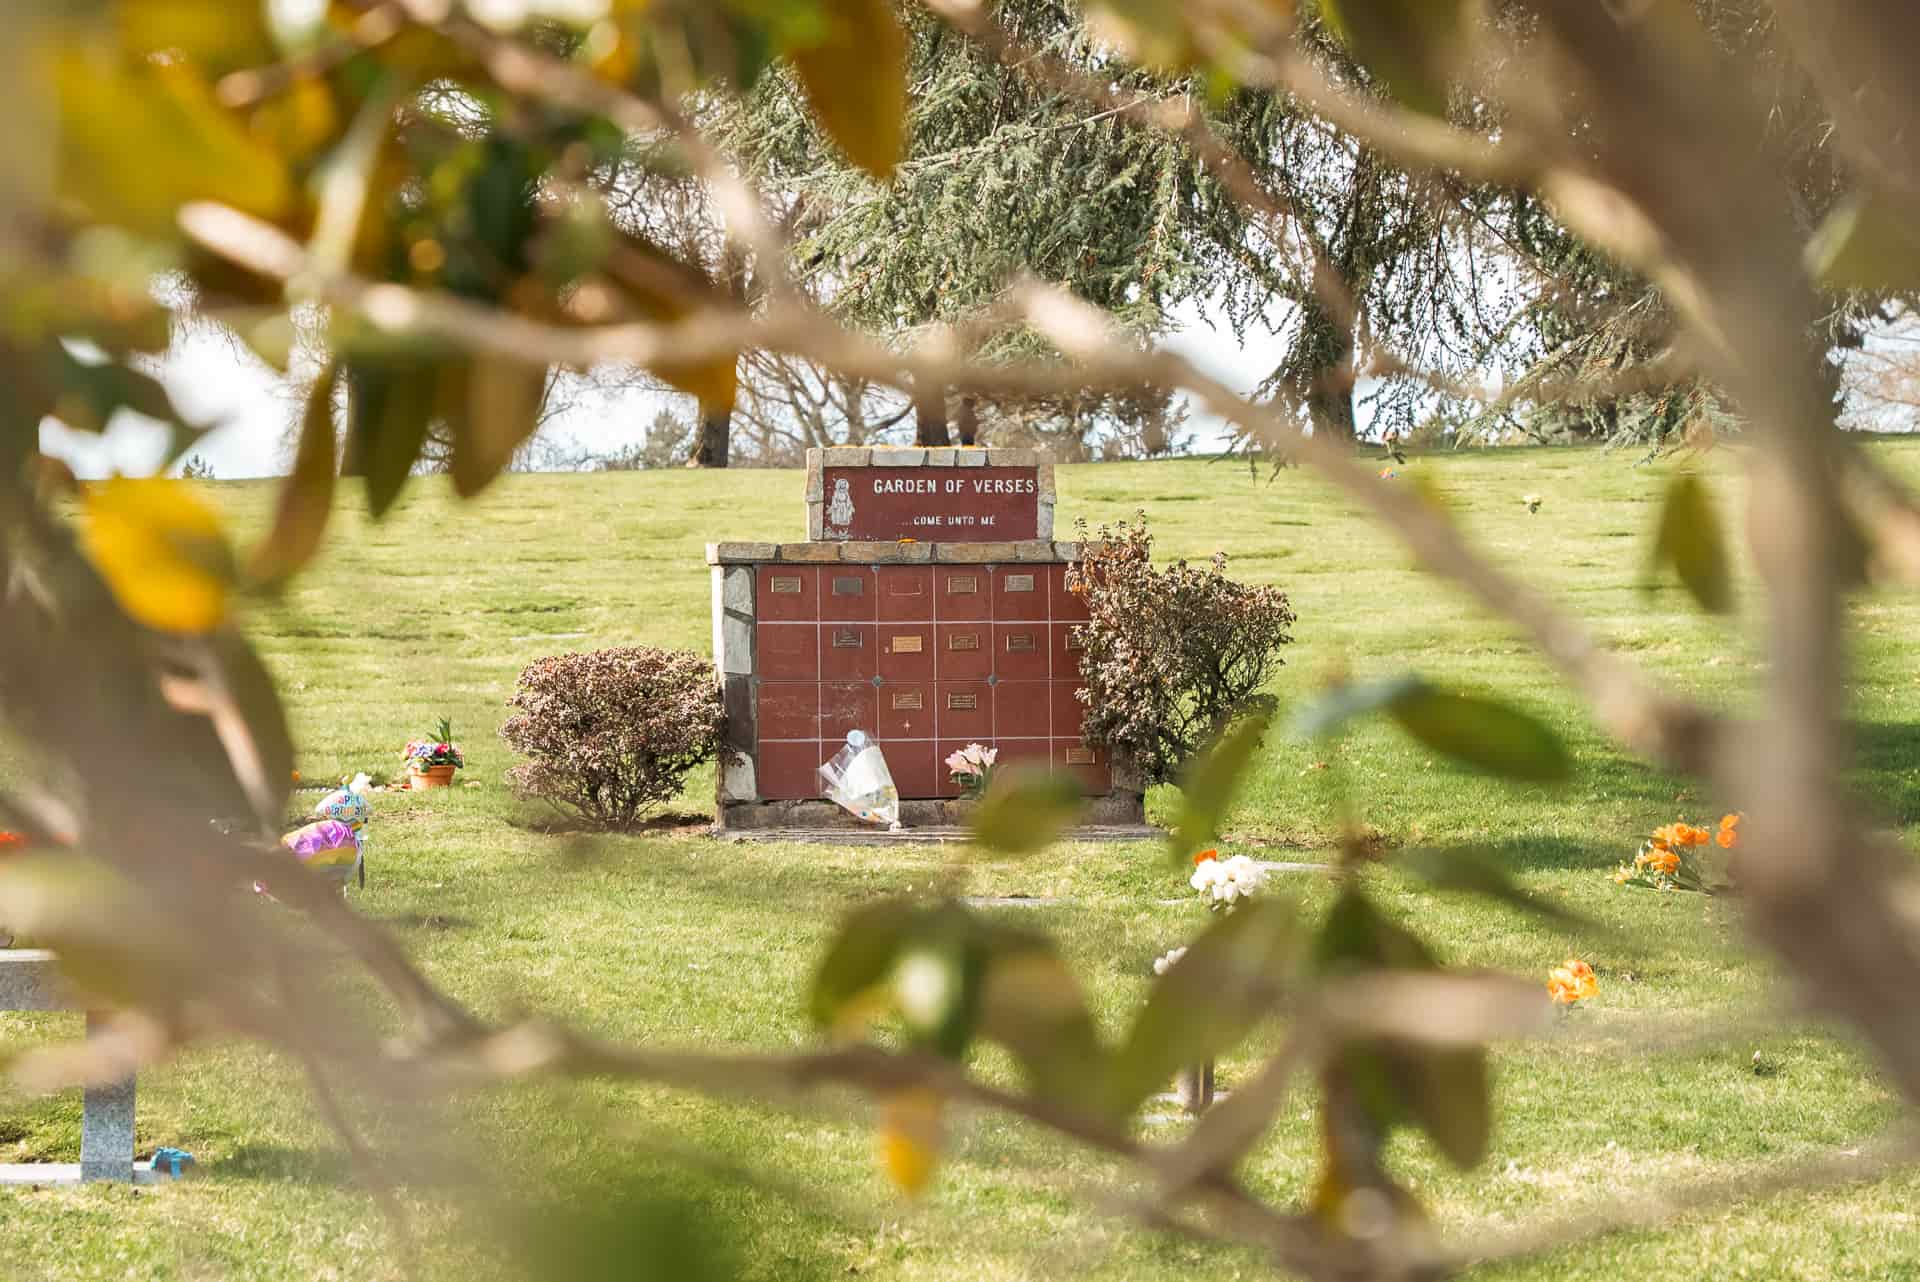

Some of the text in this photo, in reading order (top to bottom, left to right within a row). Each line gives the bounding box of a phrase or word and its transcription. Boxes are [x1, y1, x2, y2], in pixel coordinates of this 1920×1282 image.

[873, 479, 1035, 494] GARDEN OF VERSES
[947, 515, 975, 526] UNTO
[980, 515, 997, 526] ME
